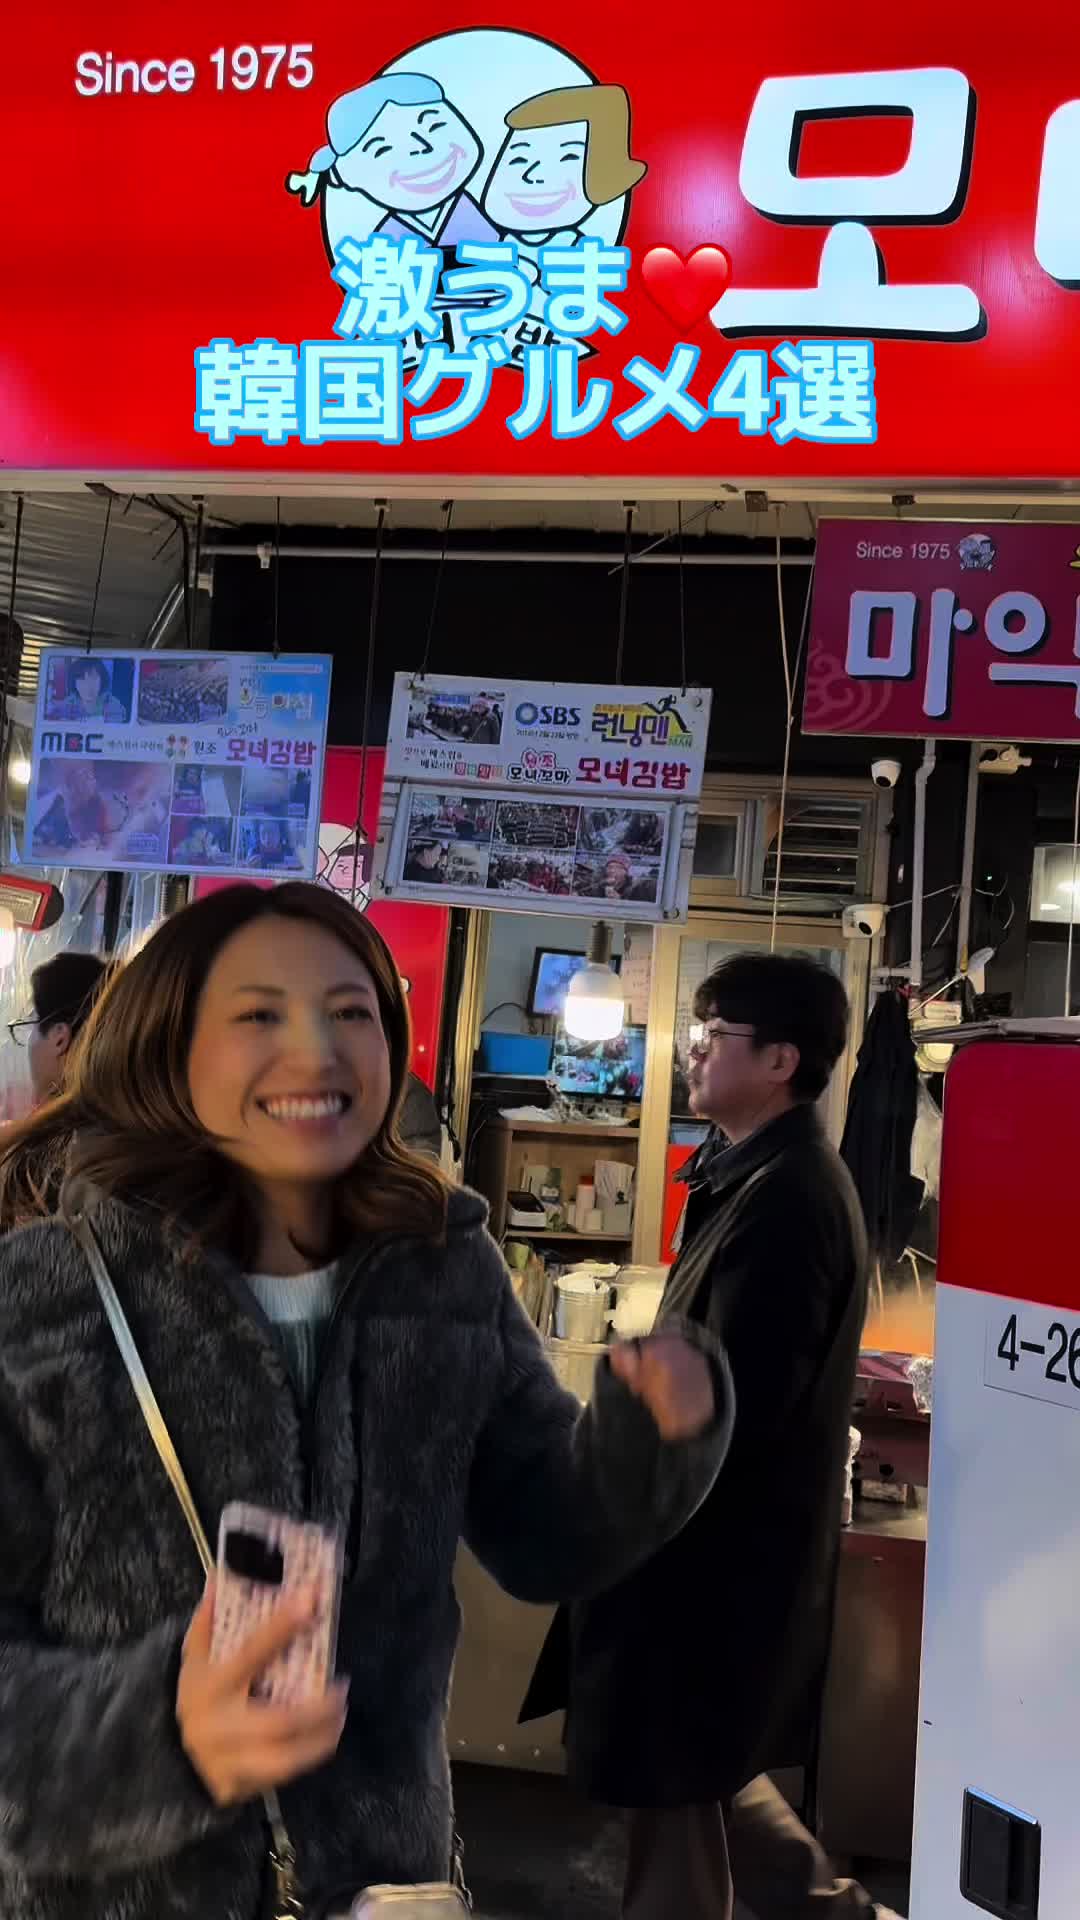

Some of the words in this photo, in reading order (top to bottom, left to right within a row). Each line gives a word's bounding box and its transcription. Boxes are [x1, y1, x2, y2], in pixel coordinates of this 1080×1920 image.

[75, 52, 194, 96] Since
[210, 44, 314, 90] 1975
[856, 542, 903, 559] Since
[911, 543, 950, 560] 1975
[539, 706, 582, 727] SBS
[592, 711, 670, 748] 런닝맨
[41, 731, 104, 753] MBC
[226, 736, 317, 766] 모녀김밥
[575, 757, 692, 791] 모녀김밥
